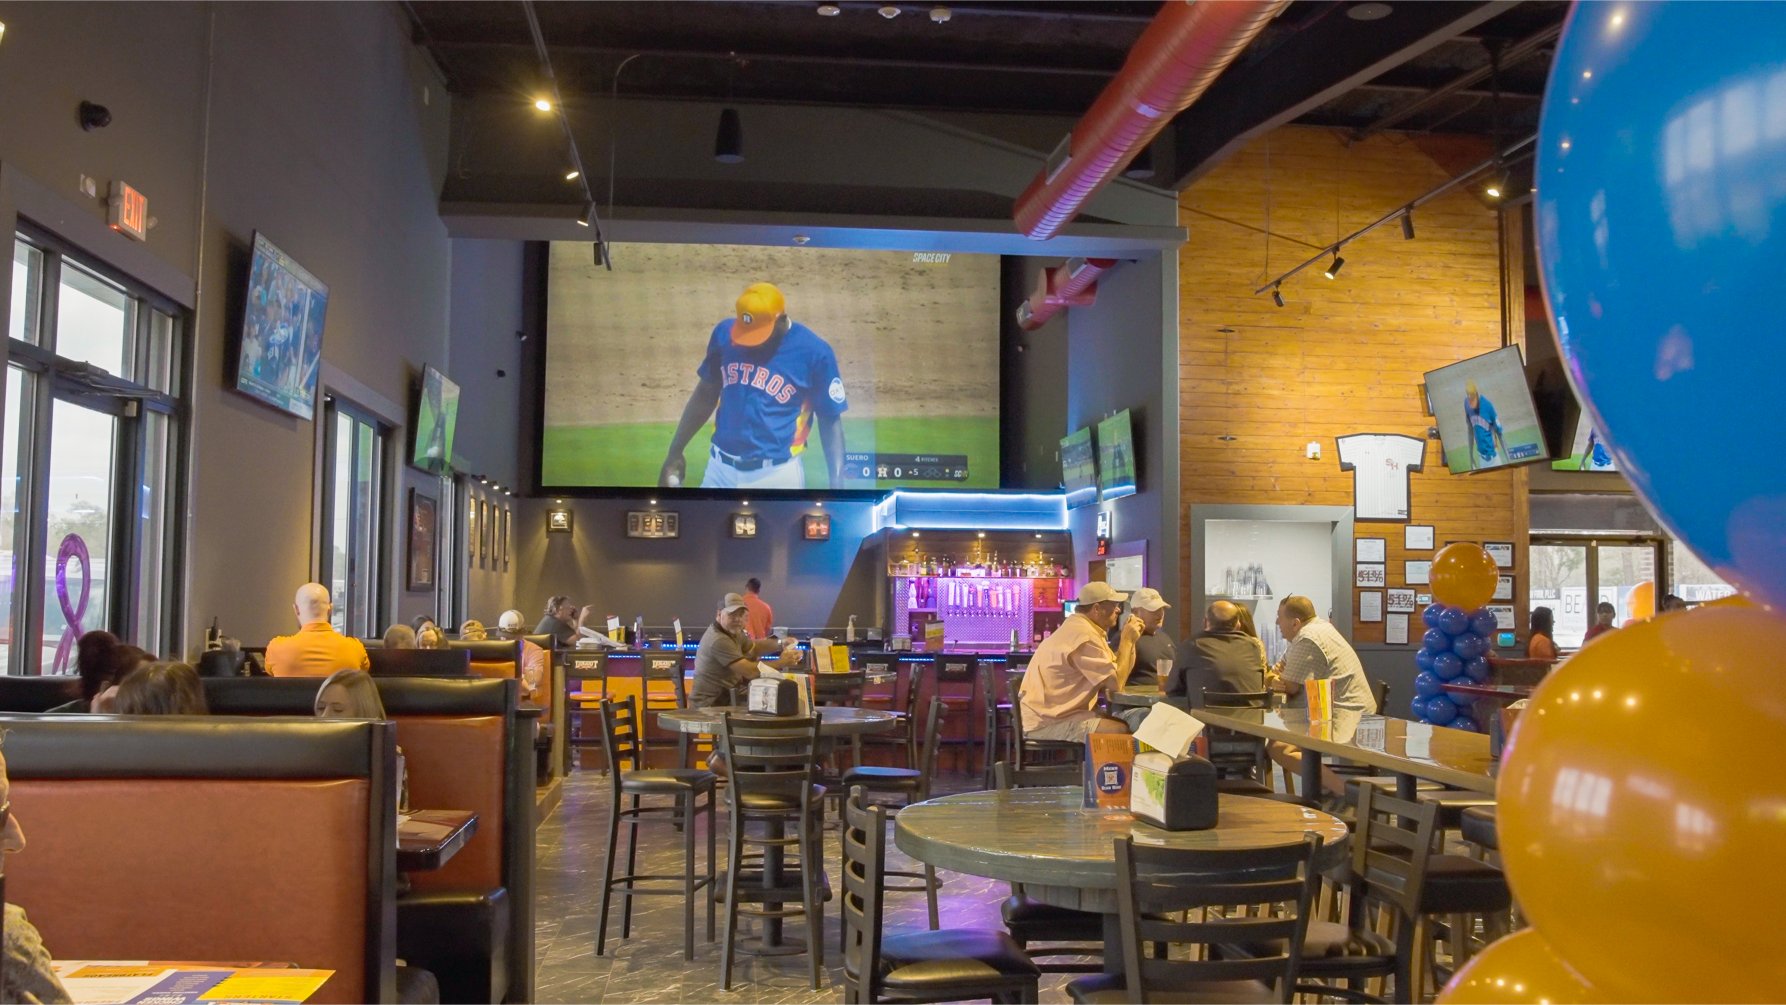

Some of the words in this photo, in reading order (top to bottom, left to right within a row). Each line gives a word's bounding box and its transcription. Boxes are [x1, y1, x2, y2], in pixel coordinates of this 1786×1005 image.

[124, 186, 145, 233] EXIT
[912, 252, 935, 263] SPACE
[935, 253, 952, 264] CITY
[862, 466, 870, 477] 0
[893, 467, 902, 477] 0
[1388, 593, 1414, 606] 51%
